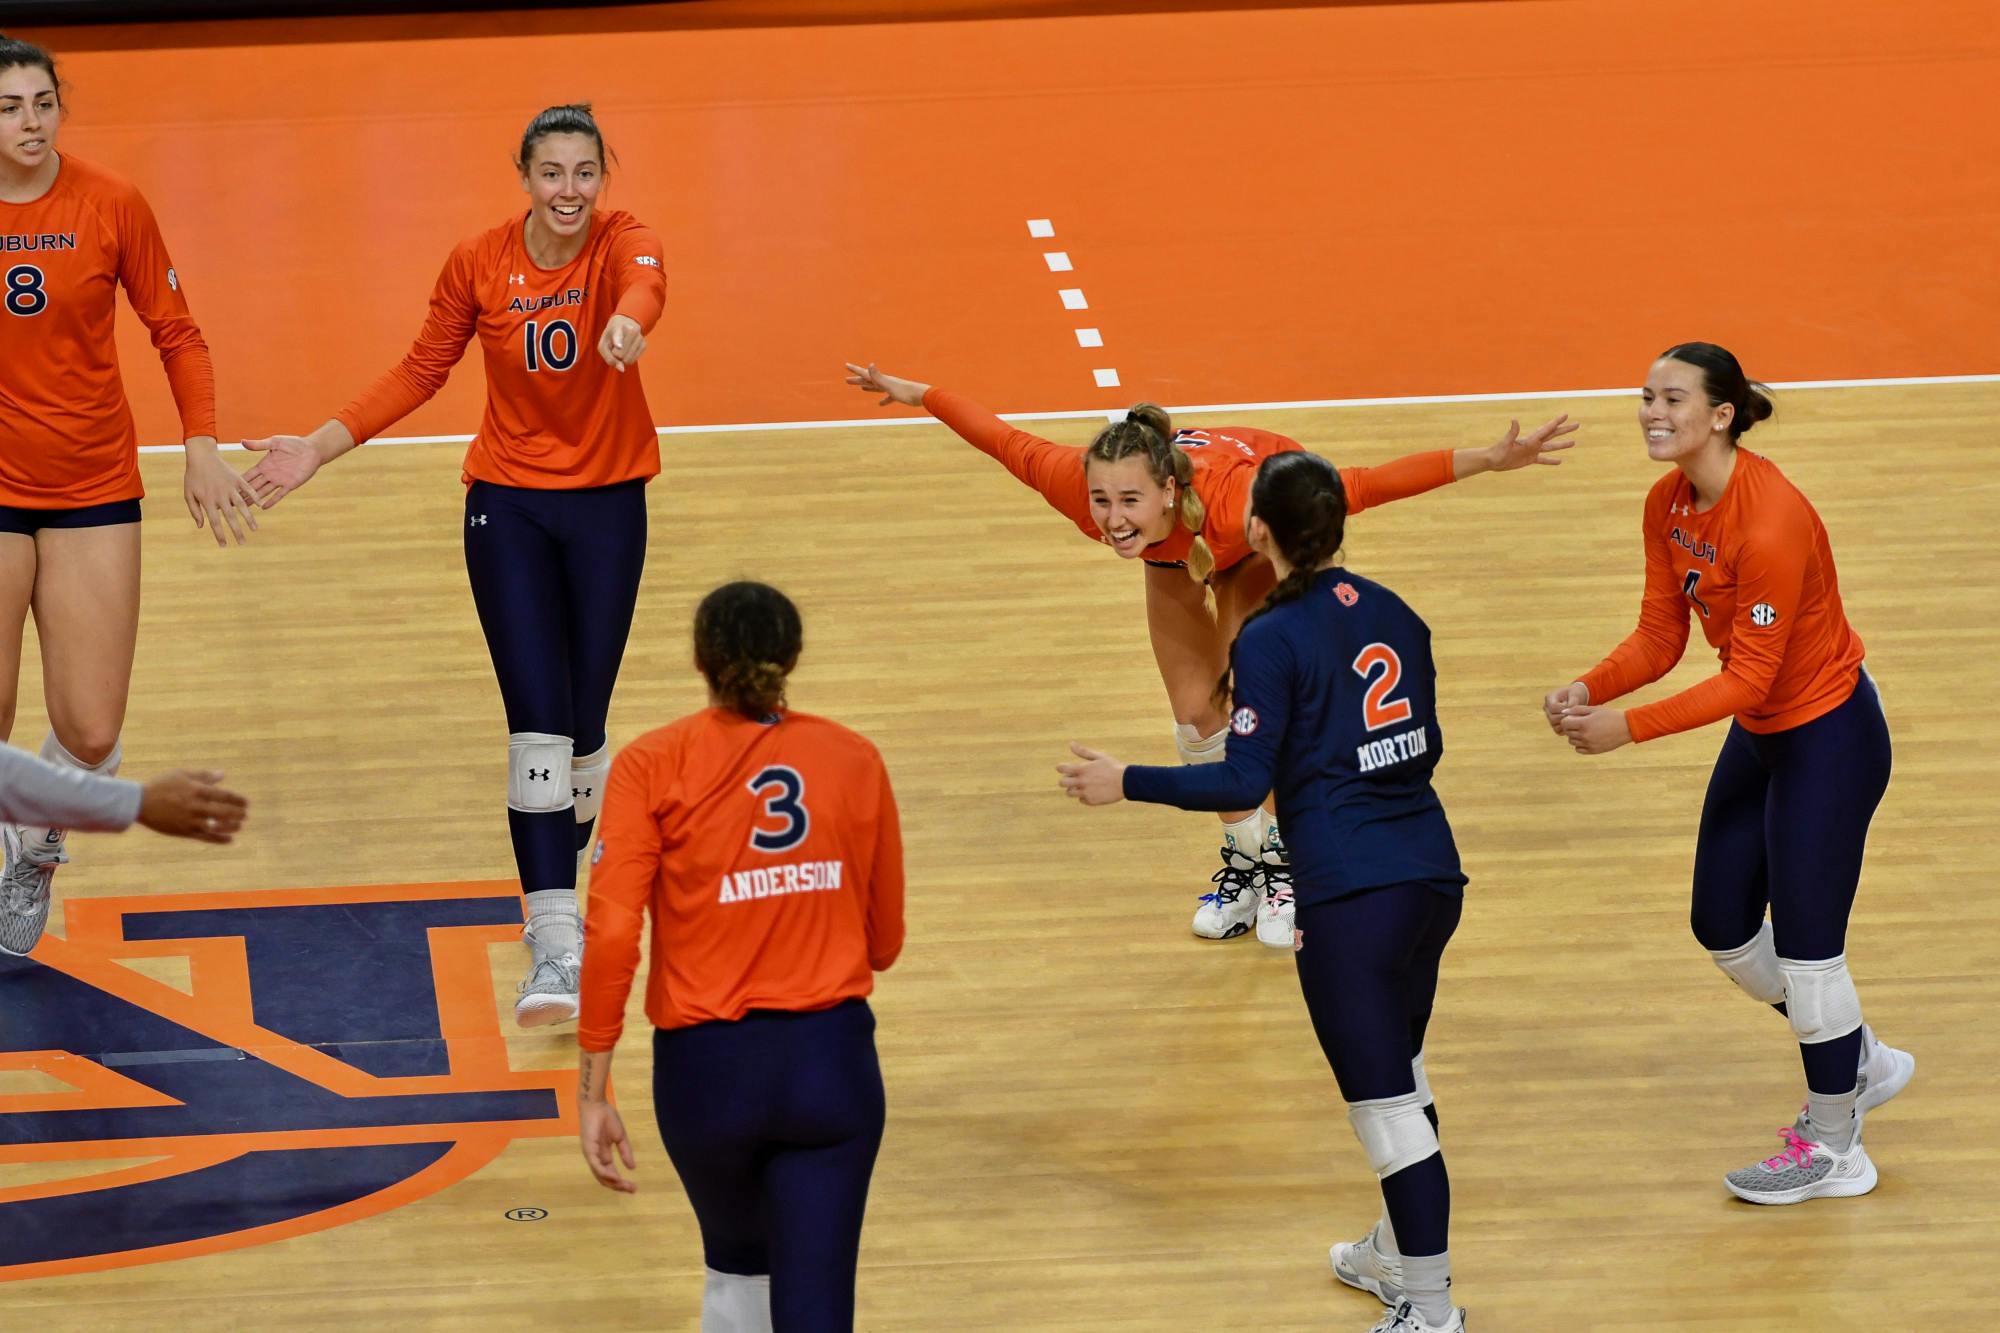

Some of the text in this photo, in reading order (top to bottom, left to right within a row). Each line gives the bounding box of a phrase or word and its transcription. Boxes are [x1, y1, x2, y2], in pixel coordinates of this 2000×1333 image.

[5, 264, 48, 317] 8
[525, 319, 578, 372] 10
[1751, 602, 1776, 626] SEC
[1352, 642, 1412, 732] 2
[1232, 706, 1259, 736] SEC
[1356, 726, 1428, 773] MORTON
[746, 764, 810, 854] 3
[718, 860, 843, 904] ANDERSON
